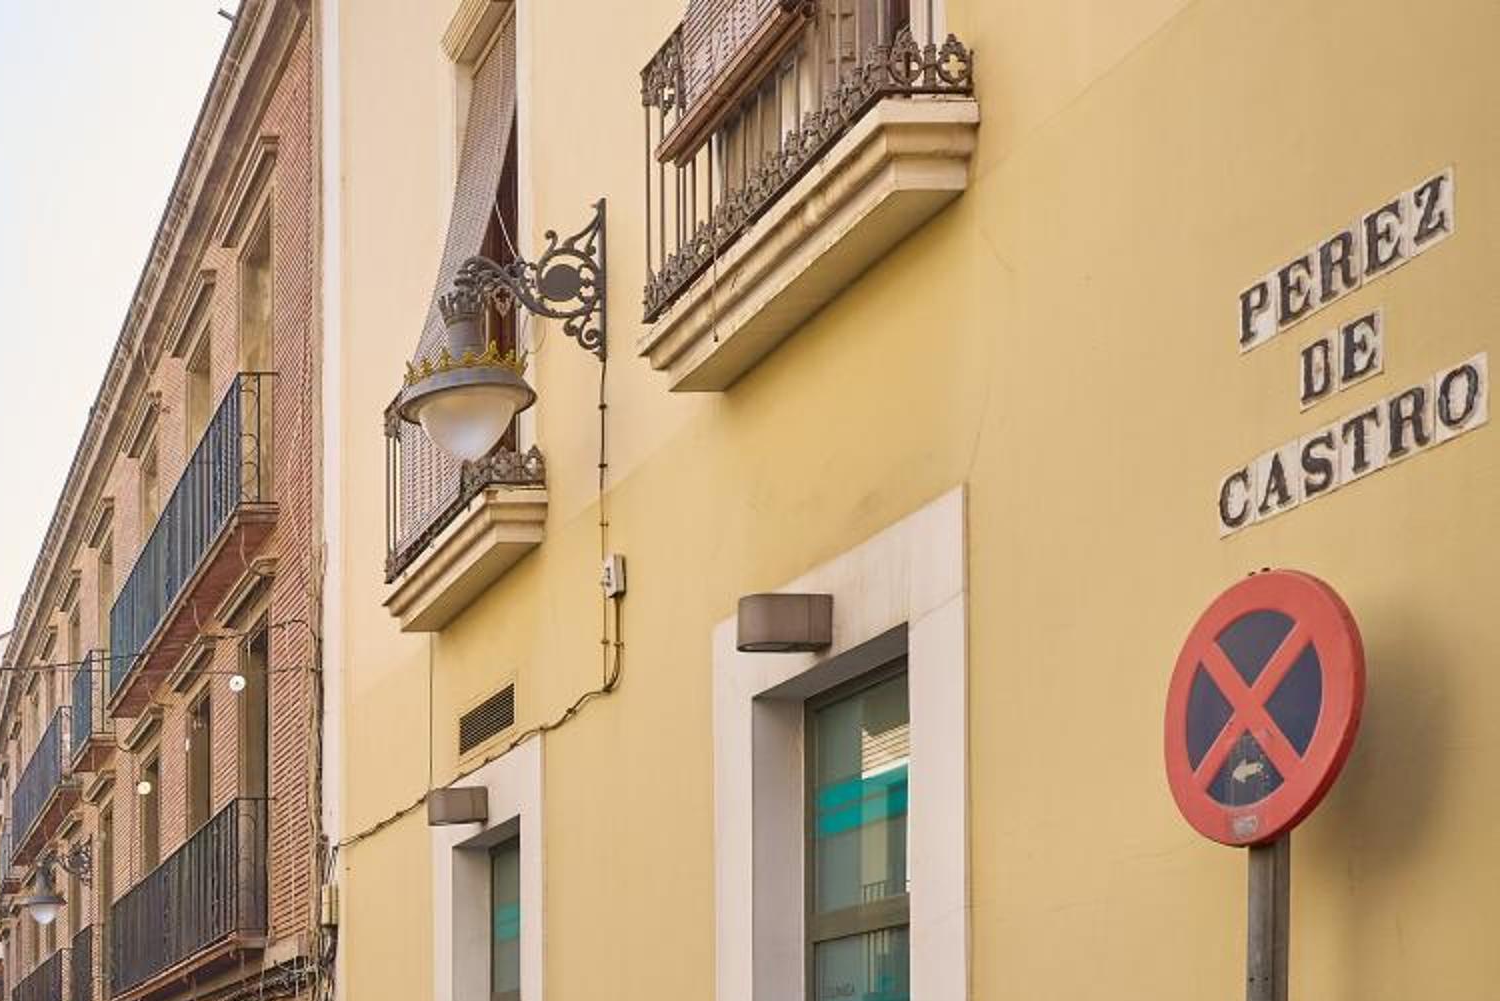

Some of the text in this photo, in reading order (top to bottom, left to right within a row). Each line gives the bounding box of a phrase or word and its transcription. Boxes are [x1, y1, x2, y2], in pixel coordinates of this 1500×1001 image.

[1239, 174, 1450, 345] PEREZ
[1301, 312, 1380, 404] DE
[1218, 363, 1480, 528] CASTRO
